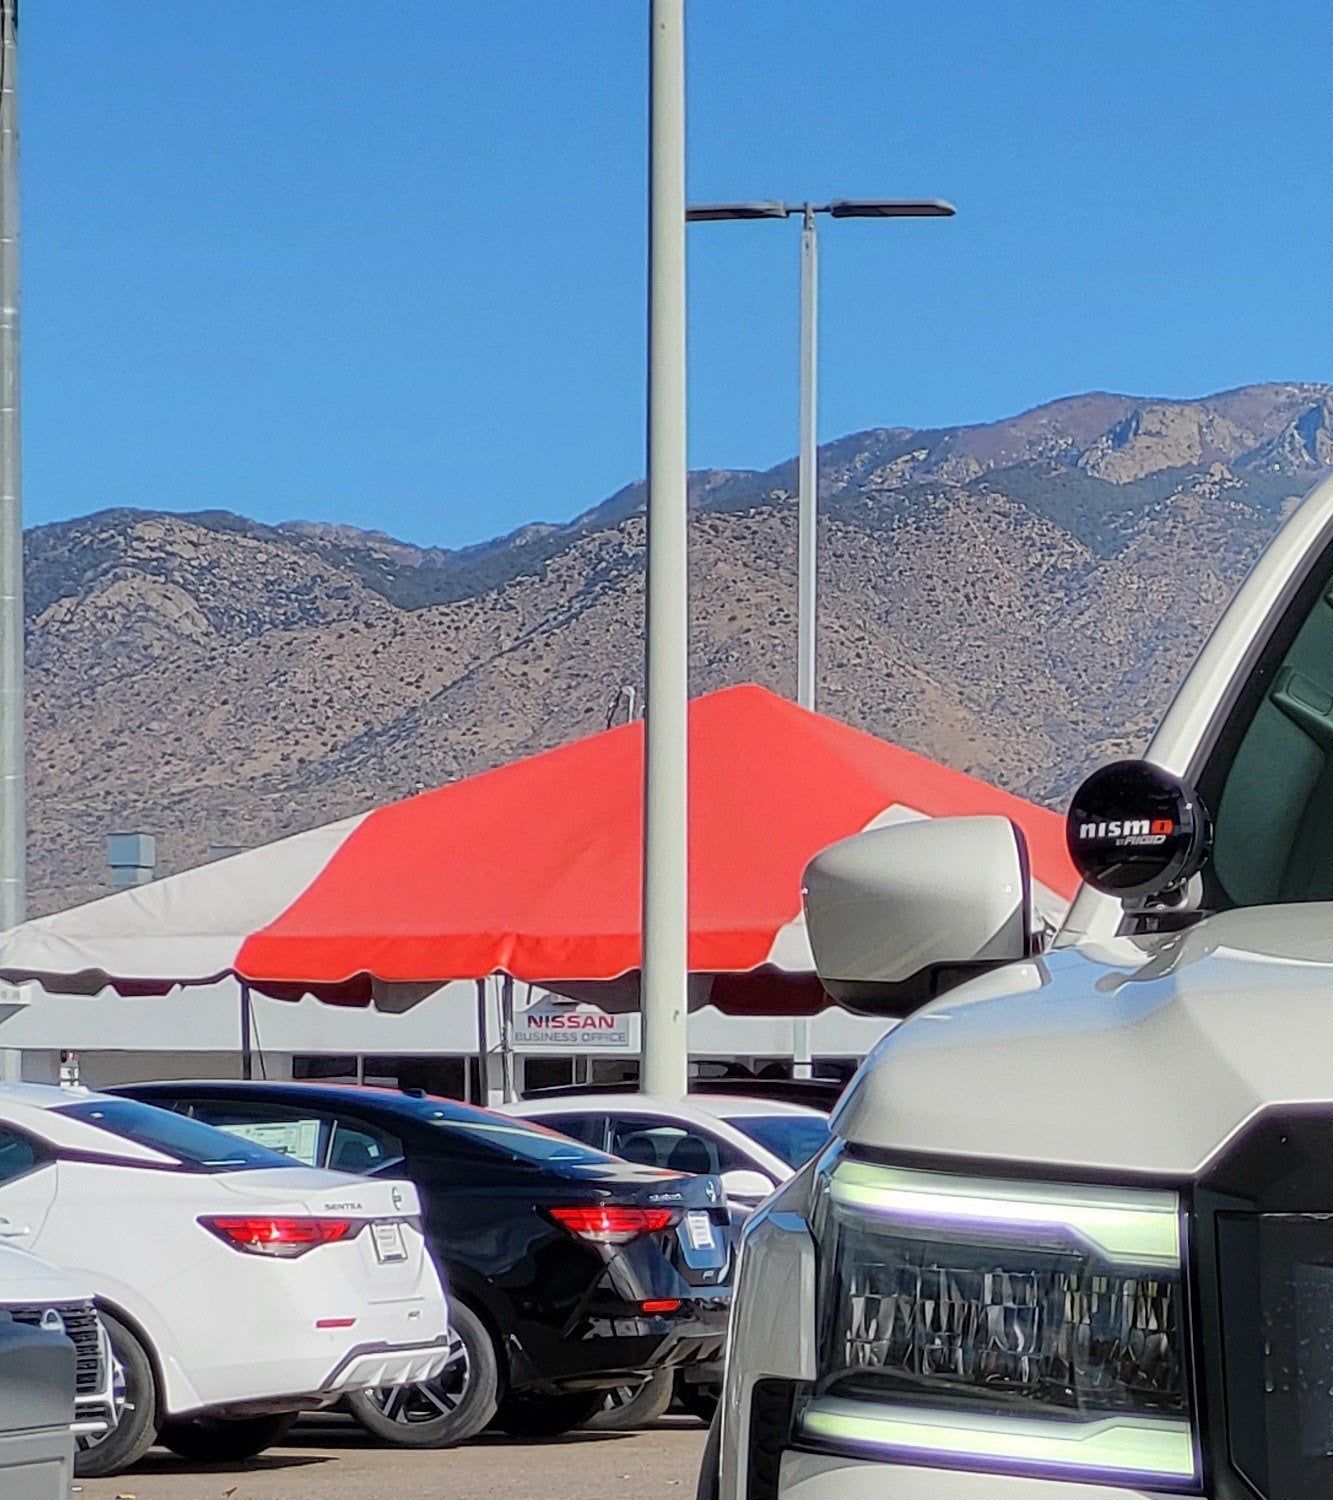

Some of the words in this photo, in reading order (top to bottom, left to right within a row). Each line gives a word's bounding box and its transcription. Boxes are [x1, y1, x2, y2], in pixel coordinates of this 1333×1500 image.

[1079, 819, 1174, 839] nismo
[527, 1014, 614, 1029] NISSAN
[515, 1032, 578, 1042] BUSINESS
[581, 1032, 627, 1042] OFFICE
